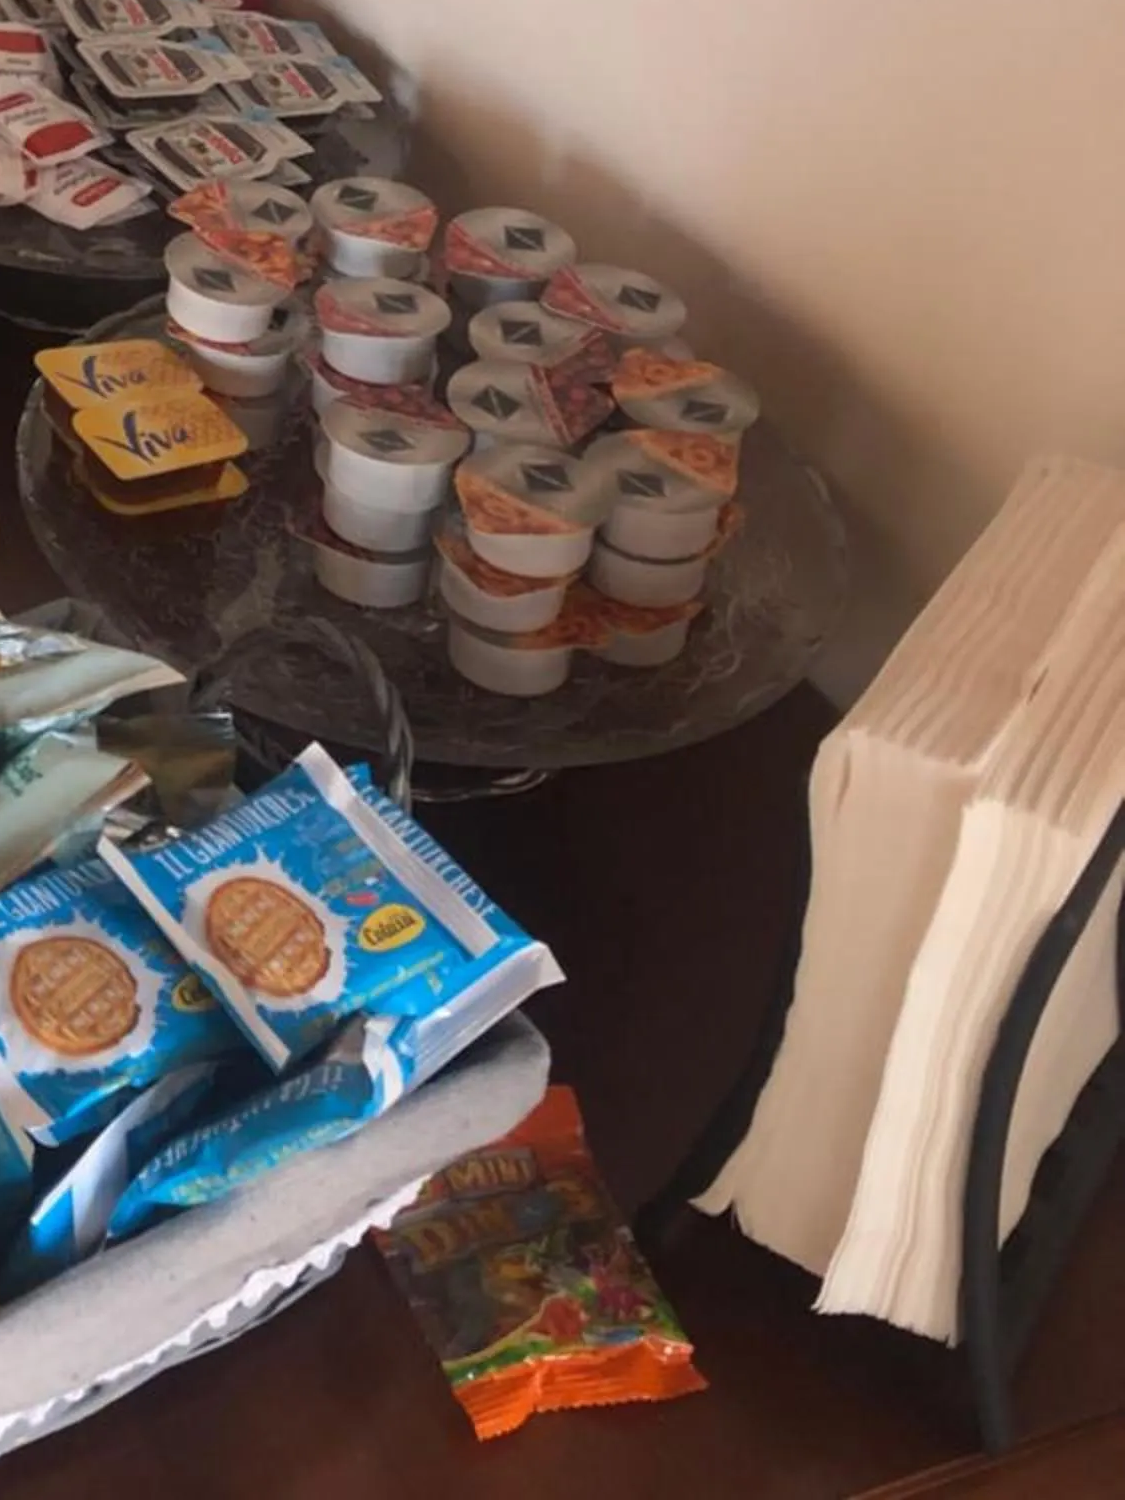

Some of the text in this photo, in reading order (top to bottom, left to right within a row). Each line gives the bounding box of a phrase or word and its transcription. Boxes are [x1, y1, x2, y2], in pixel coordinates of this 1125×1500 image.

[54, 356, 147, 399] Viva
[93, 410, 189, 466] Viva
[446, 1156, 532, 1192] MINI
